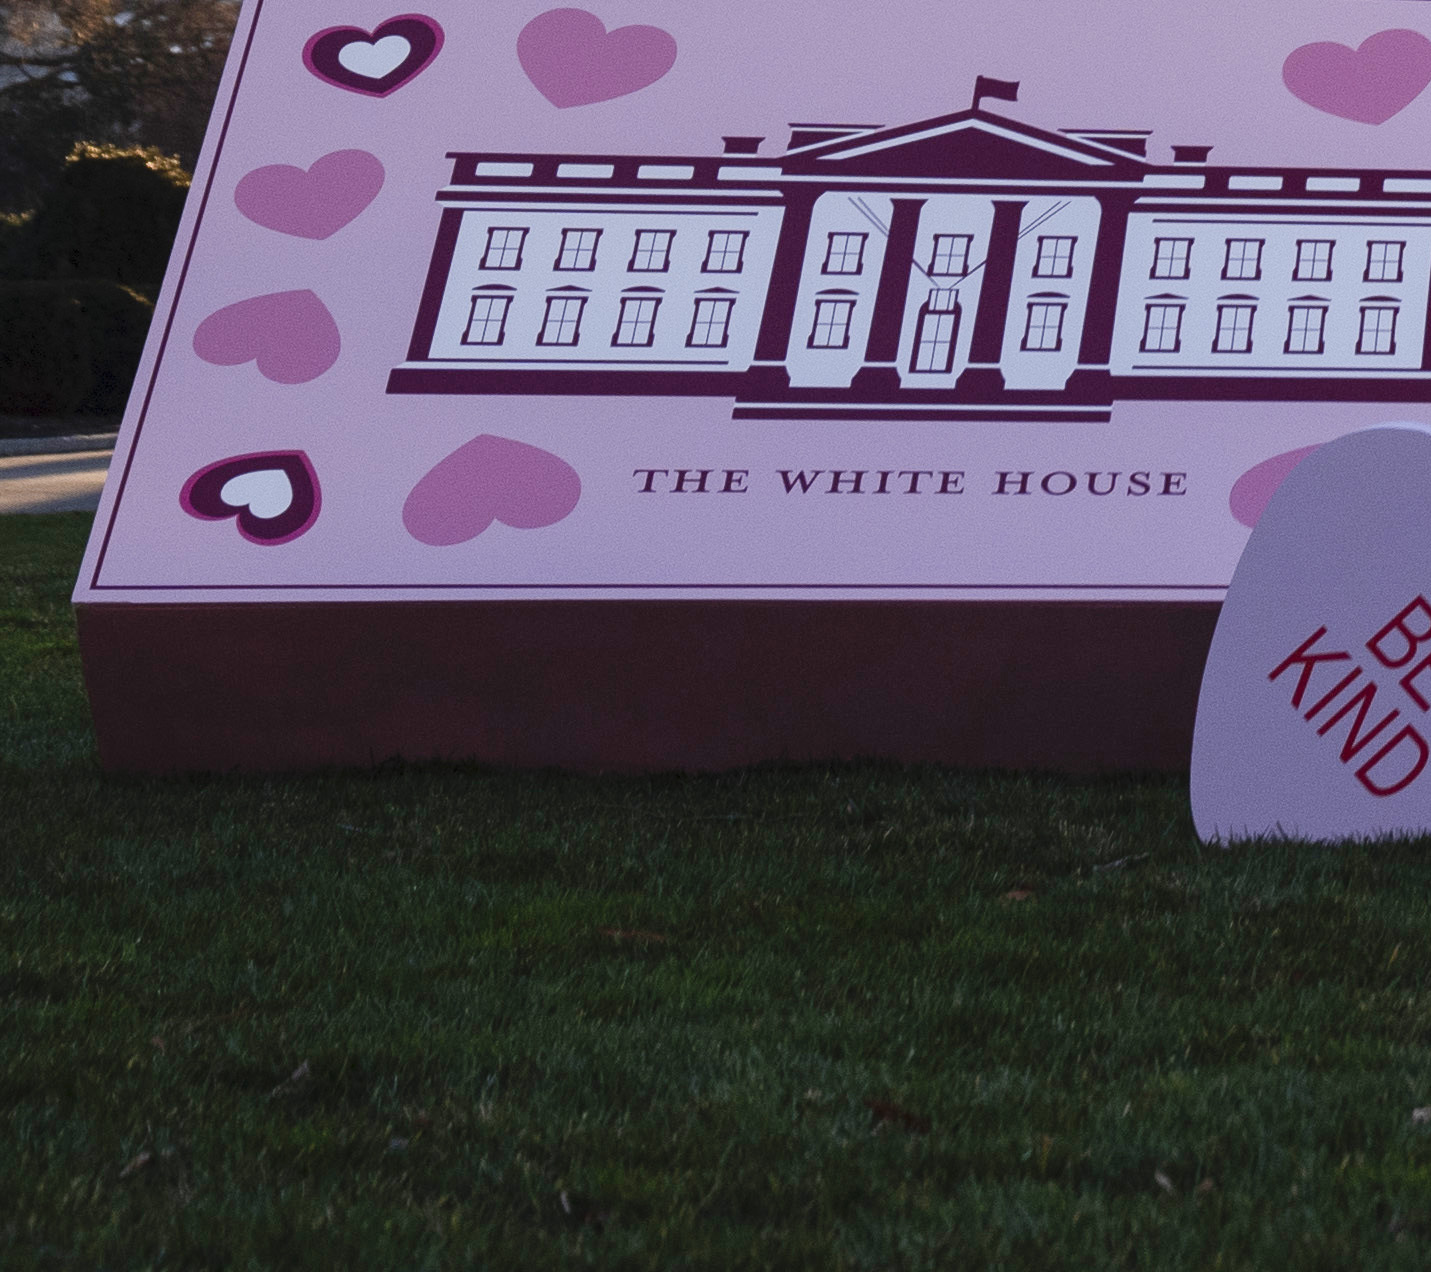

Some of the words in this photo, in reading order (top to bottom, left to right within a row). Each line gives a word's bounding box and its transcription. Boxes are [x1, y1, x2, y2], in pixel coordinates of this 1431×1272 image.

[632, 469, 749, 494] THE
[777, 469, 966, 495] WHITE
[991, 471, 1188, 497] HOUSE
[1268, 625, 1430, 798] KIND
